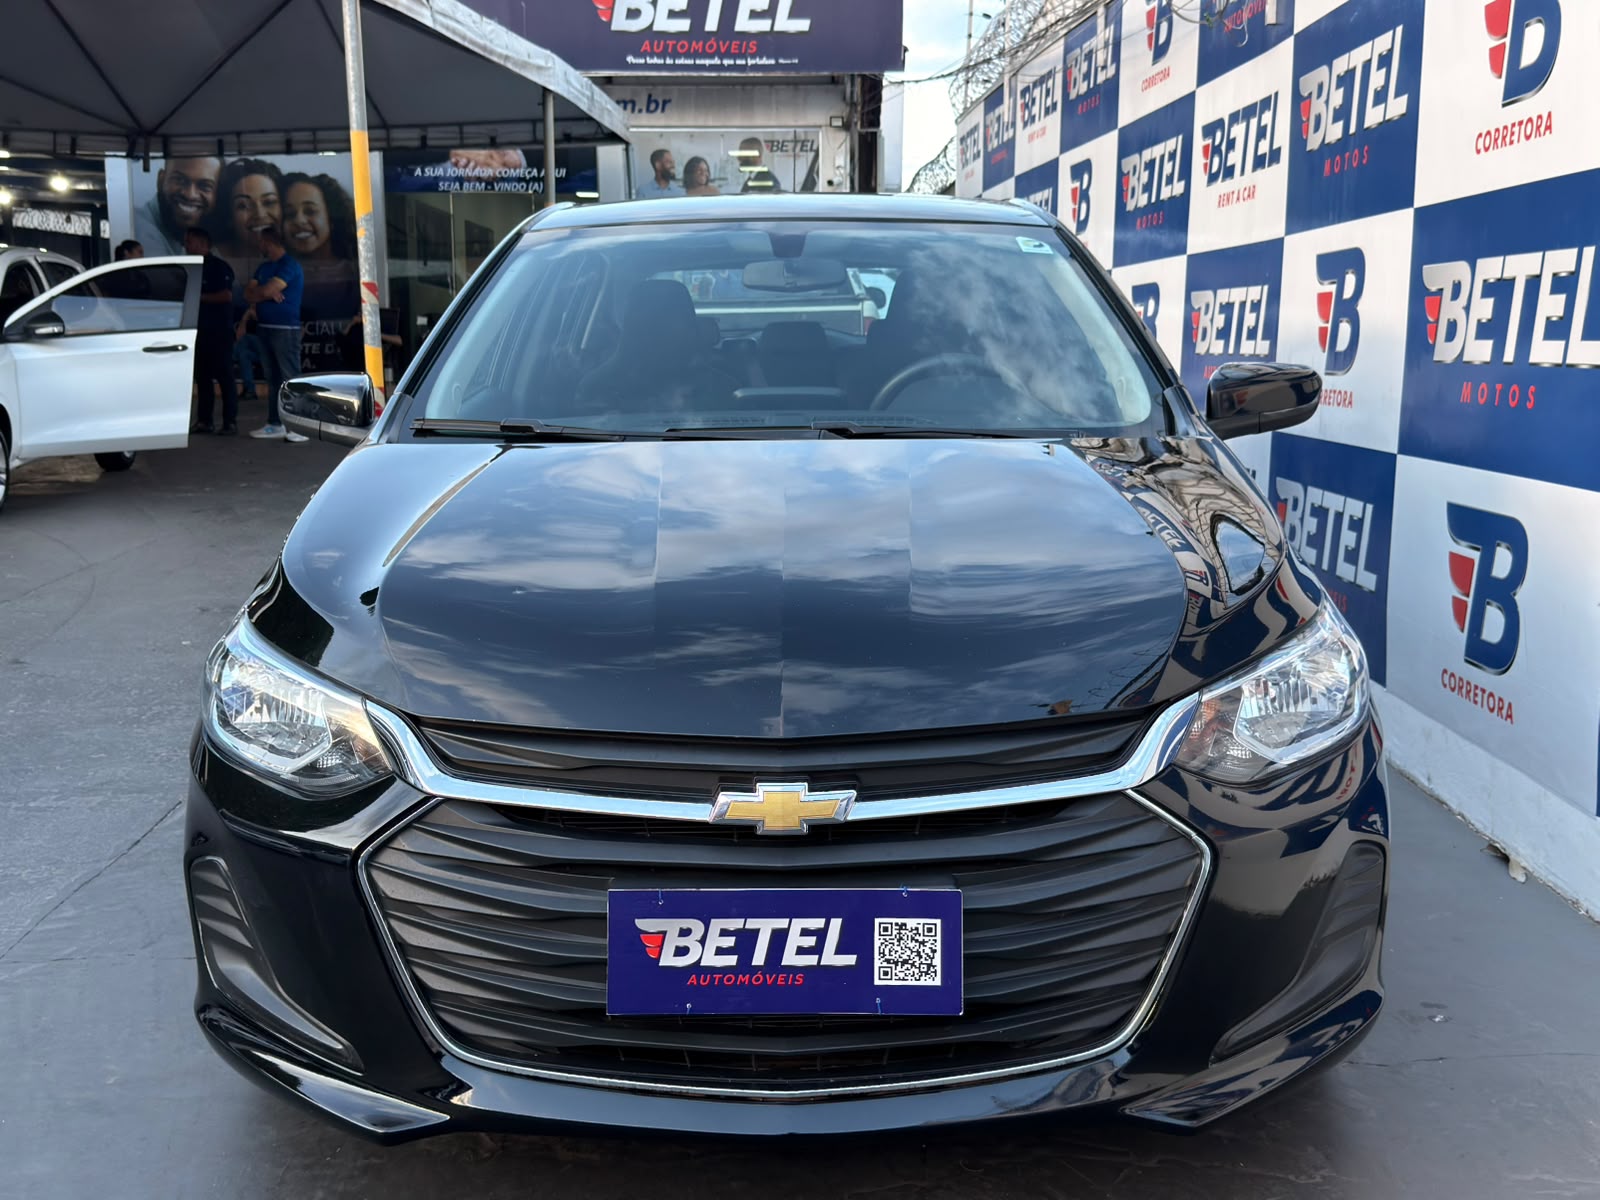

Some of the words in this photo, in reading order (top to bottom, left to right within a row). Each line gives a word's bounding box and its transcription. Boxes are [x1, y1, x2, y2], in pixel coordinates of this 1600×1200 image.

[640, 38, 758, 54] AUTOMÓVEIS
[1020, 66, 1058, 130] BETEL
[1299, 24, 1409, 151] BETEL
[764, 139, 818, 152] BETEL
[1201, 90, 1282, 187] BETEL
[1474, 111, 1552, 155] CORRETORA
[414, 167, 422, 177] A
[424, 167, 444, 177] SUA
[446, 167, 494, 178] JORNADA
[496, 168, 538, 179] COMEÇA
[540, 168, 567, 178] AUI
[1121, 134, 1185, 212] BETEL
[1323, 145, 1369, 177] MOTOS
[438, 181, 460, 192] SEJA
[463, 182, 486, 192] BEM
[494, 182, 527, 192] VINDO
[528, 182, 544, 193] (A)
[1217, 190, 1235, 208] RENT
[1236, 190, 1241, 203] A
[1242, 185, 1256, 201] CAR
[1191, 284, 1270, 356] BETEL
[1316, 247, 1366, 376] B
[1422, 245, 1600, 368] BETEL
[1319, 388, 1353, 409] RRETORA
[1460, 381, 1536, 409] MOTOS
[1276, 477, 1378, 592] BETEL
[1447, 501, 1529, 676] B
[1441, 668, 1514, 725] CORRETORA
[635, 917, 858, 968] BETEL
[687, 971, 805, 986] AUTOMÓVEIS
